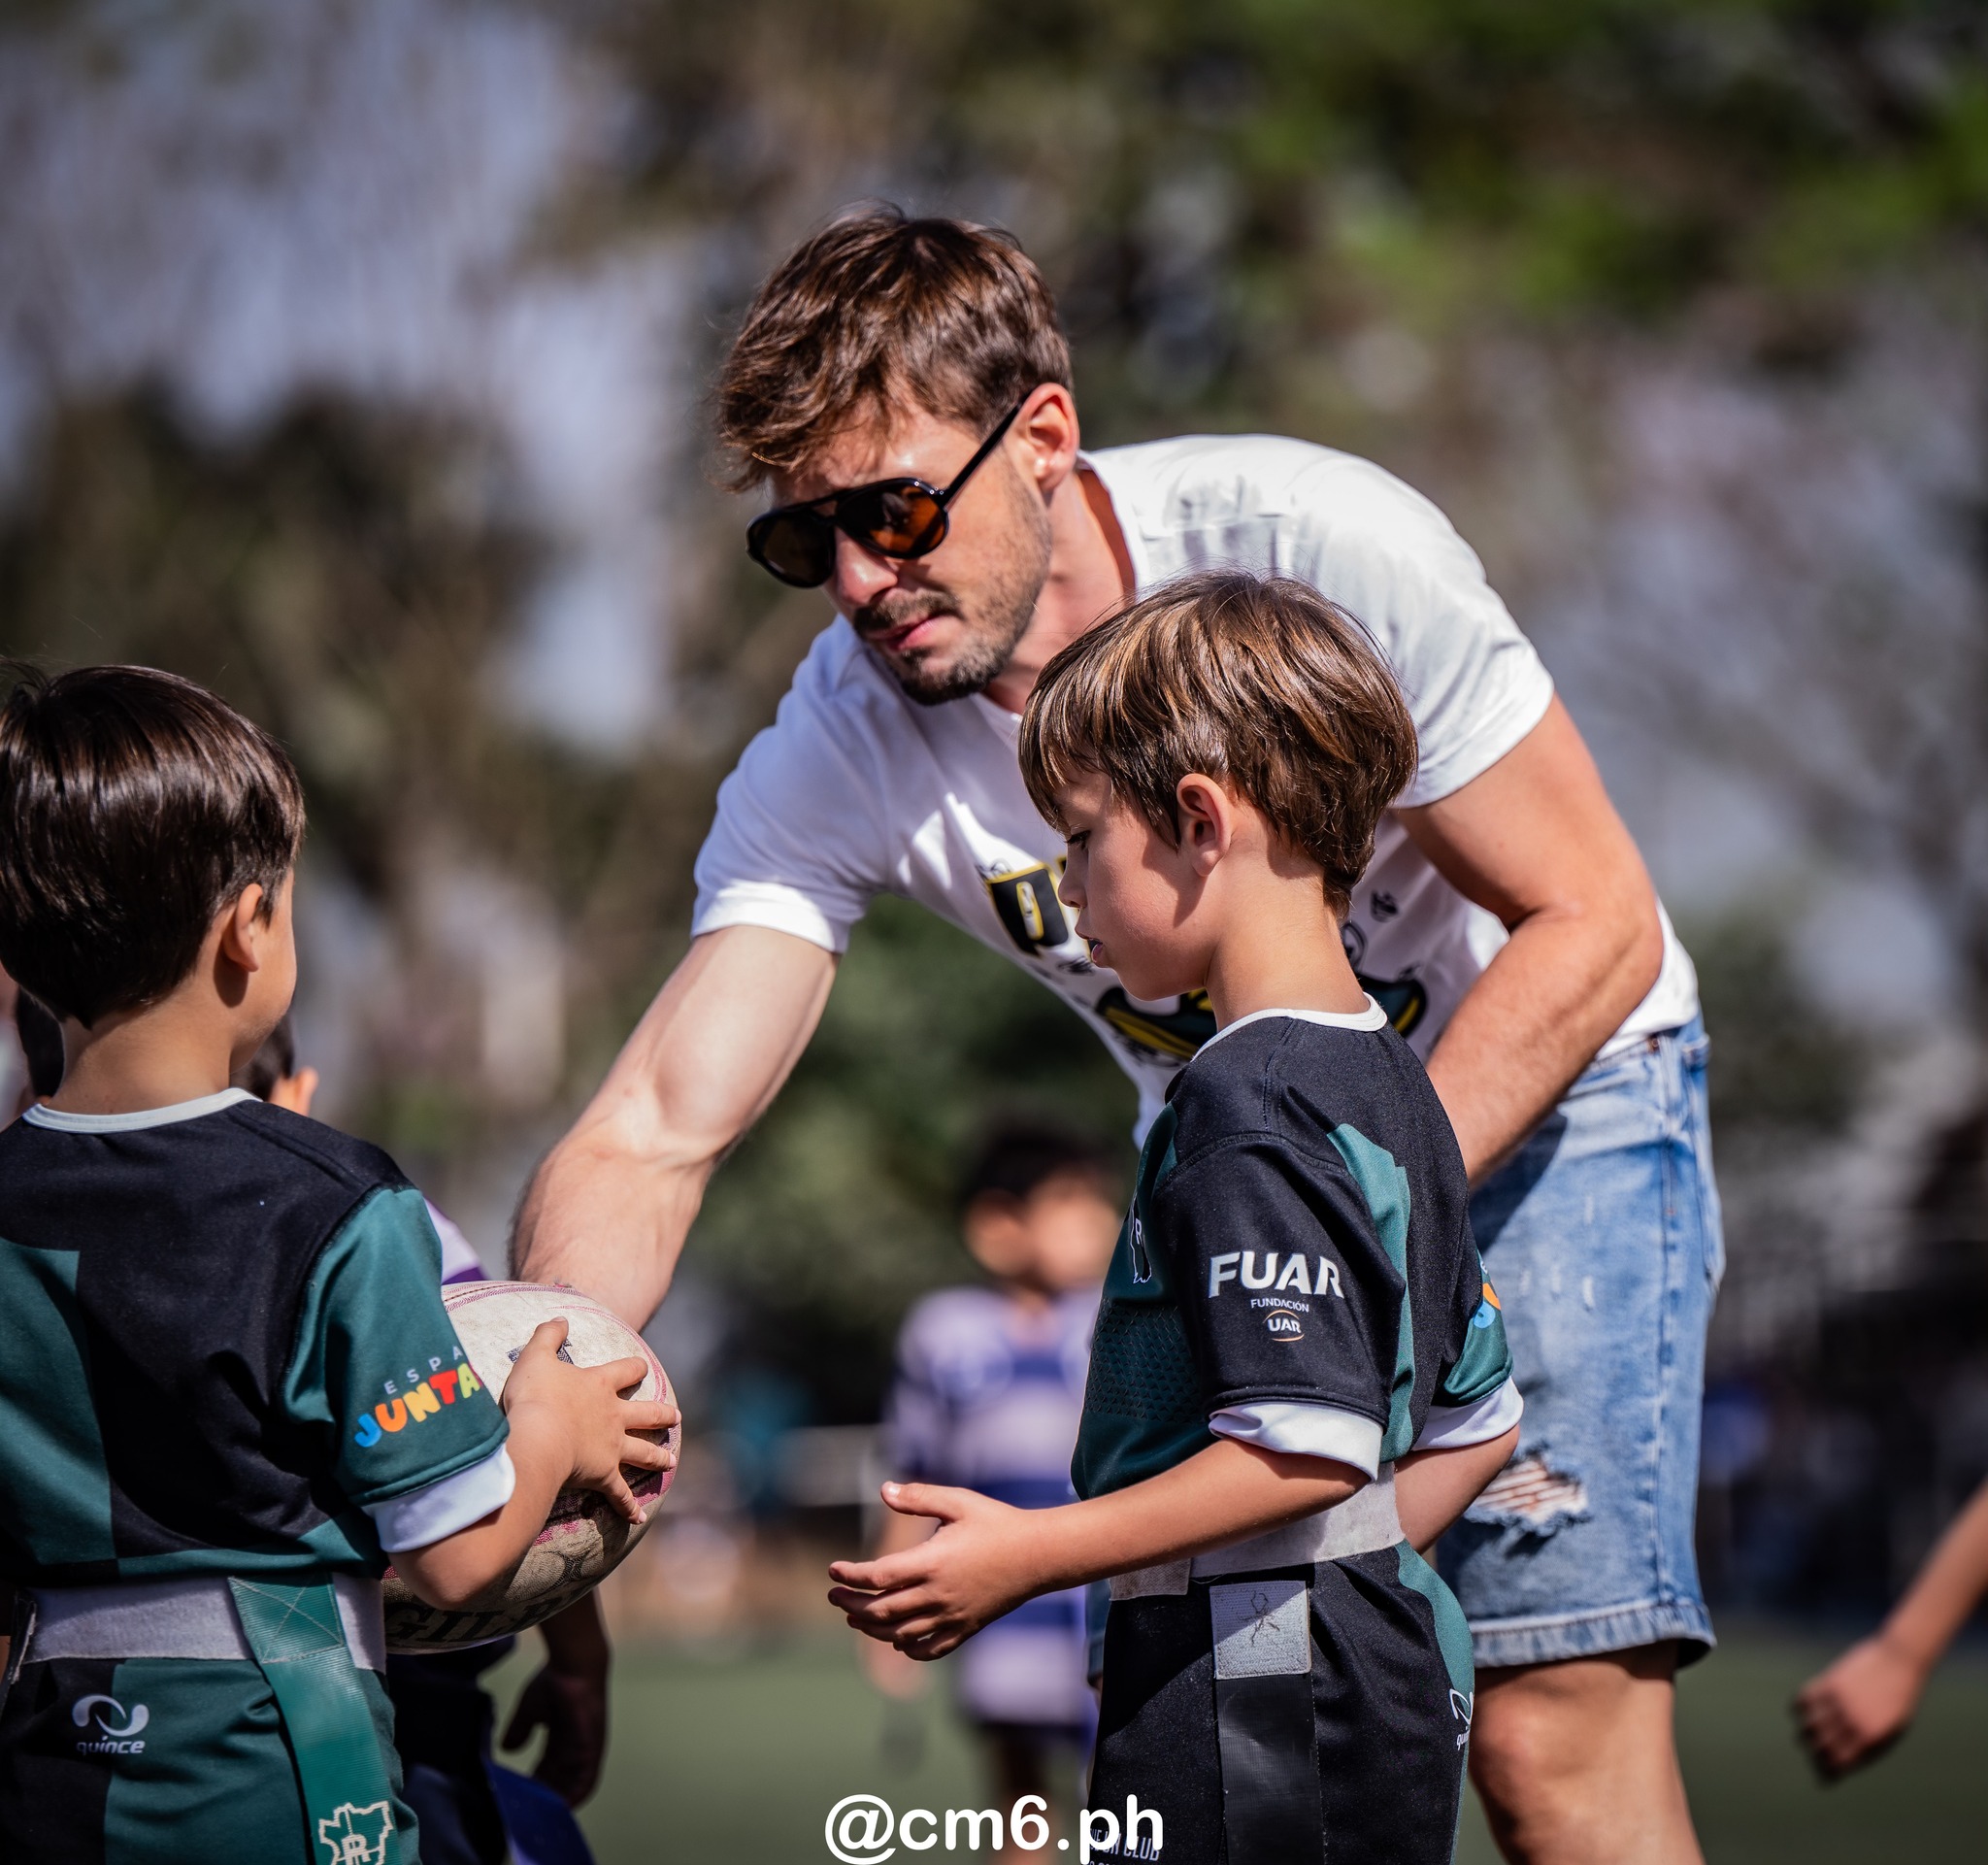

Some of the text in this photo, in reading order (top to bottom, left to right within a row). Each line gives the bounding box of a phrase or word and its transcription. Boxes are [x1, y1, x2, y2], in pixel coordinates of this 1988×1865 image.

[1209, 1250, 1344, 1299] FUAR
[1250, 1298, 1309, 1313] FUNDACIÓN
[1267, 1317, 1302, 1333] UAR
[354, 1362, 482, 1448] JUNTA
[76, 1735, 147, 1755] quince
